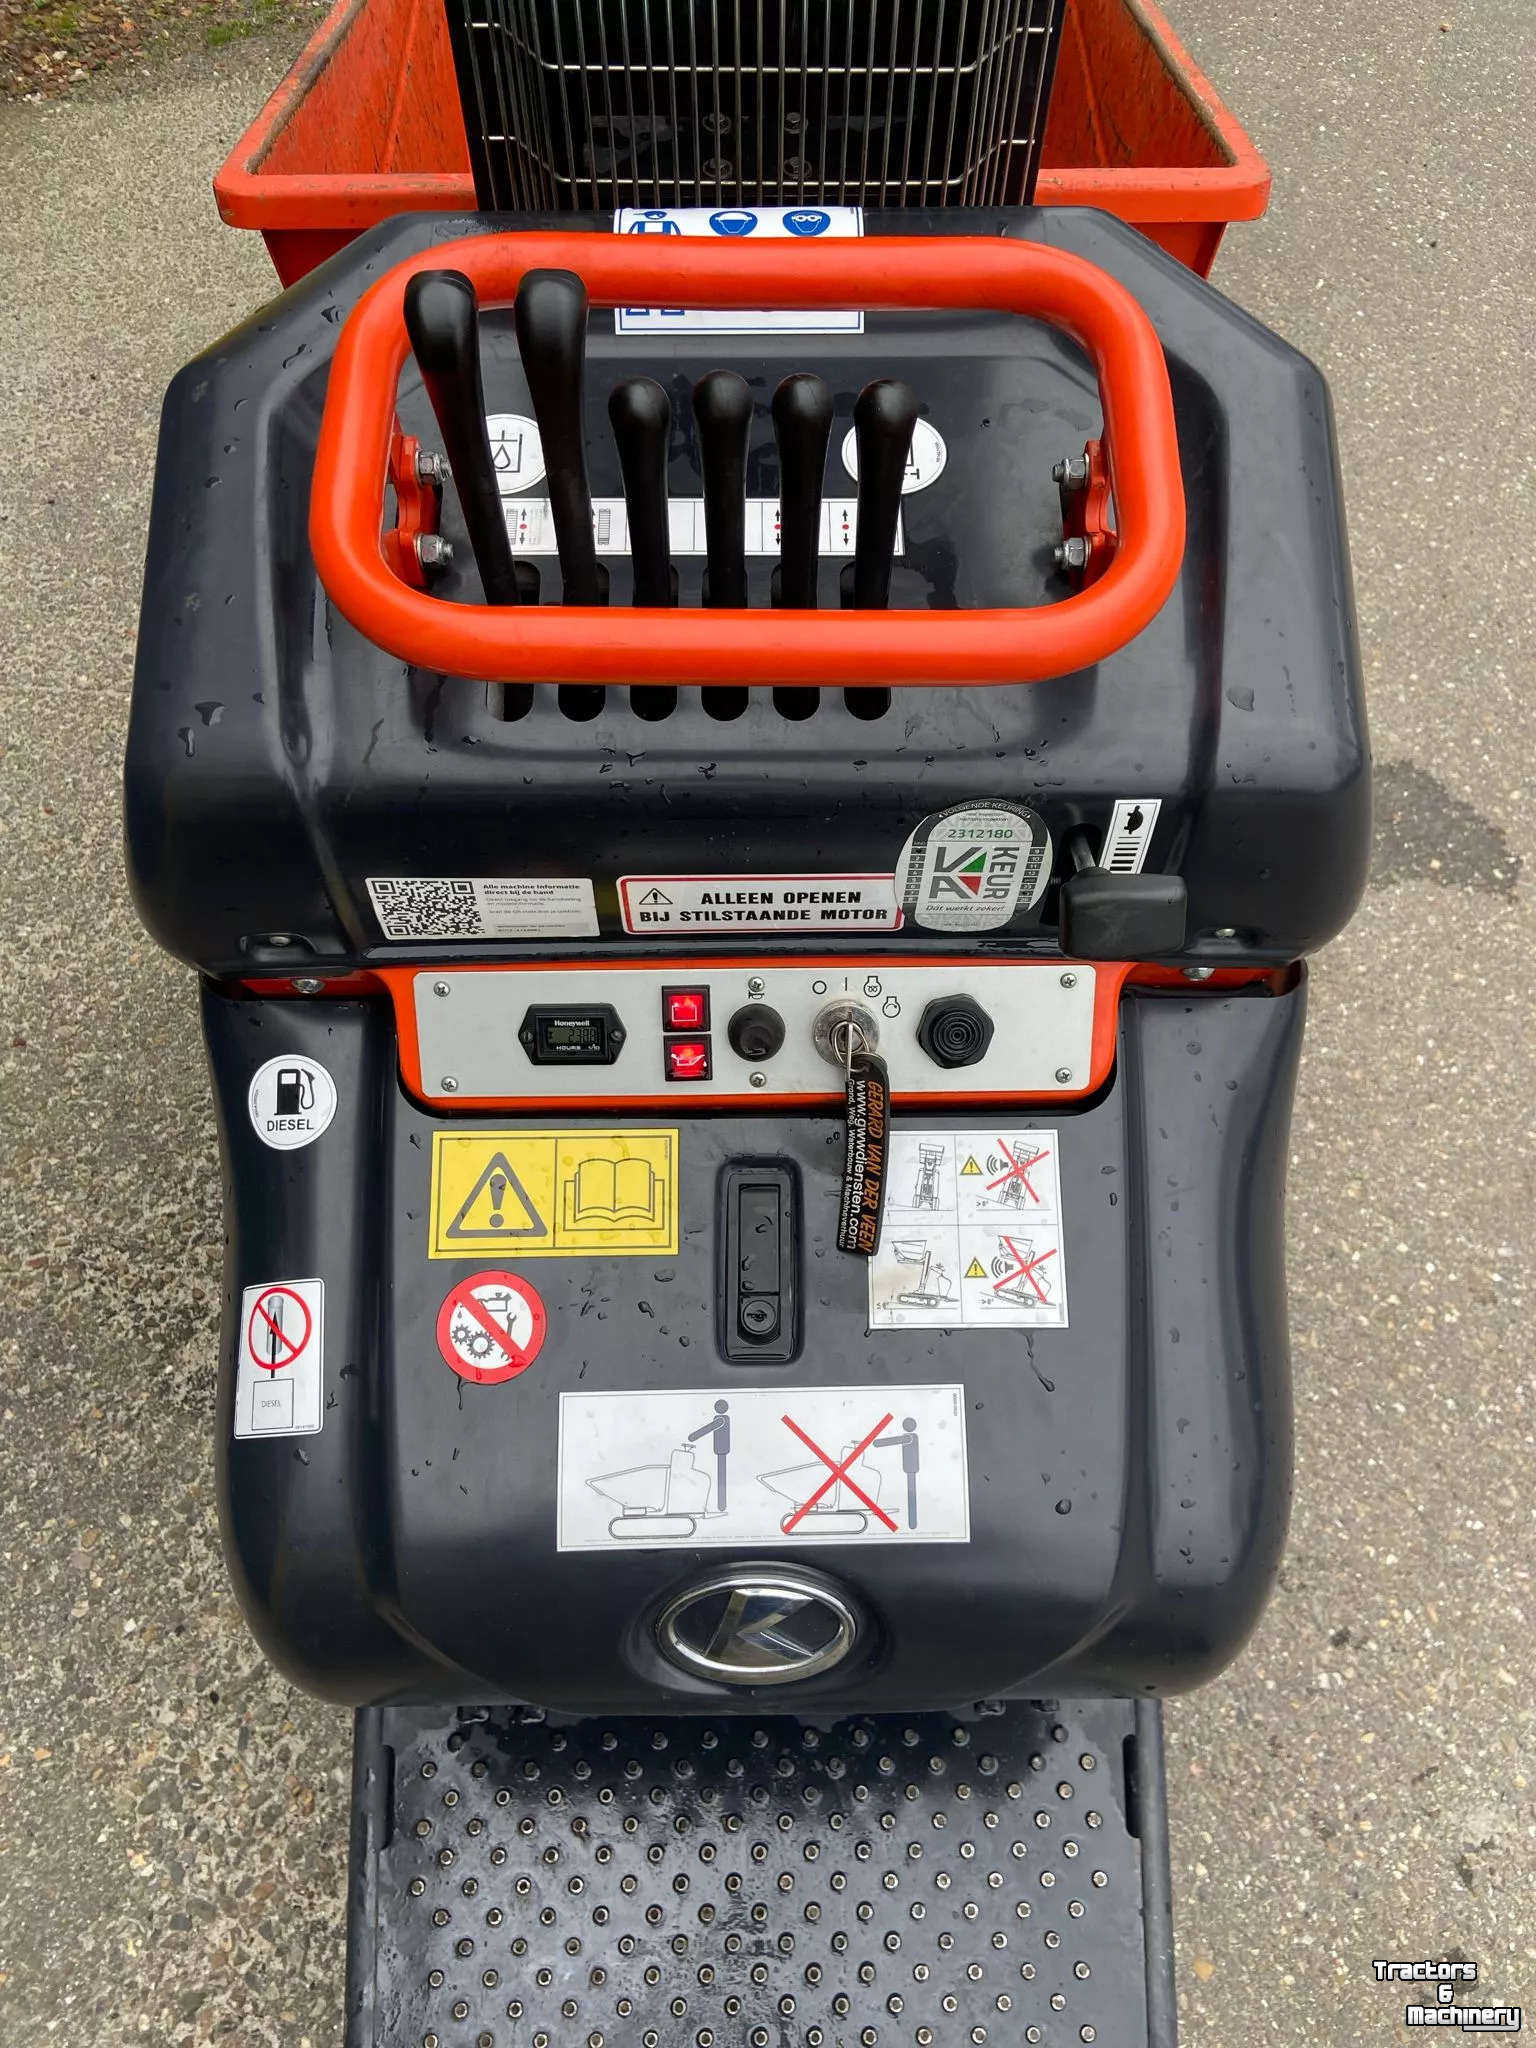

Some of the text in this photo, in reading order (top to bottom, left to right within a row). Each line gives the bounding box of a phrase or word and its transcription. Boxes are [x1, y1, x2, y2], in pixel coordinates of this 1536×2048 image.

[943, 802, 1030, 818] VOLGENDE KEURING
[948, 829, 1013, 839] 2312180
[983, 847, 1019, 900] KEUR
[701, 891, 861, 905] ALLEEN OPENEN
[640, 909, 888, 923] BIJ STILSTAANDE MOTOR
[267, 1119, 314, 1131] DIESEL
[846, 1129, 856, 1175] Waterbouw
[846, 1080, 866, 1250] www.gwwdiensten.com
[858, 1079, 884, 1254] GERARD VAN DER VEEN
[261, 1400, 282, 1408] DIESEL
